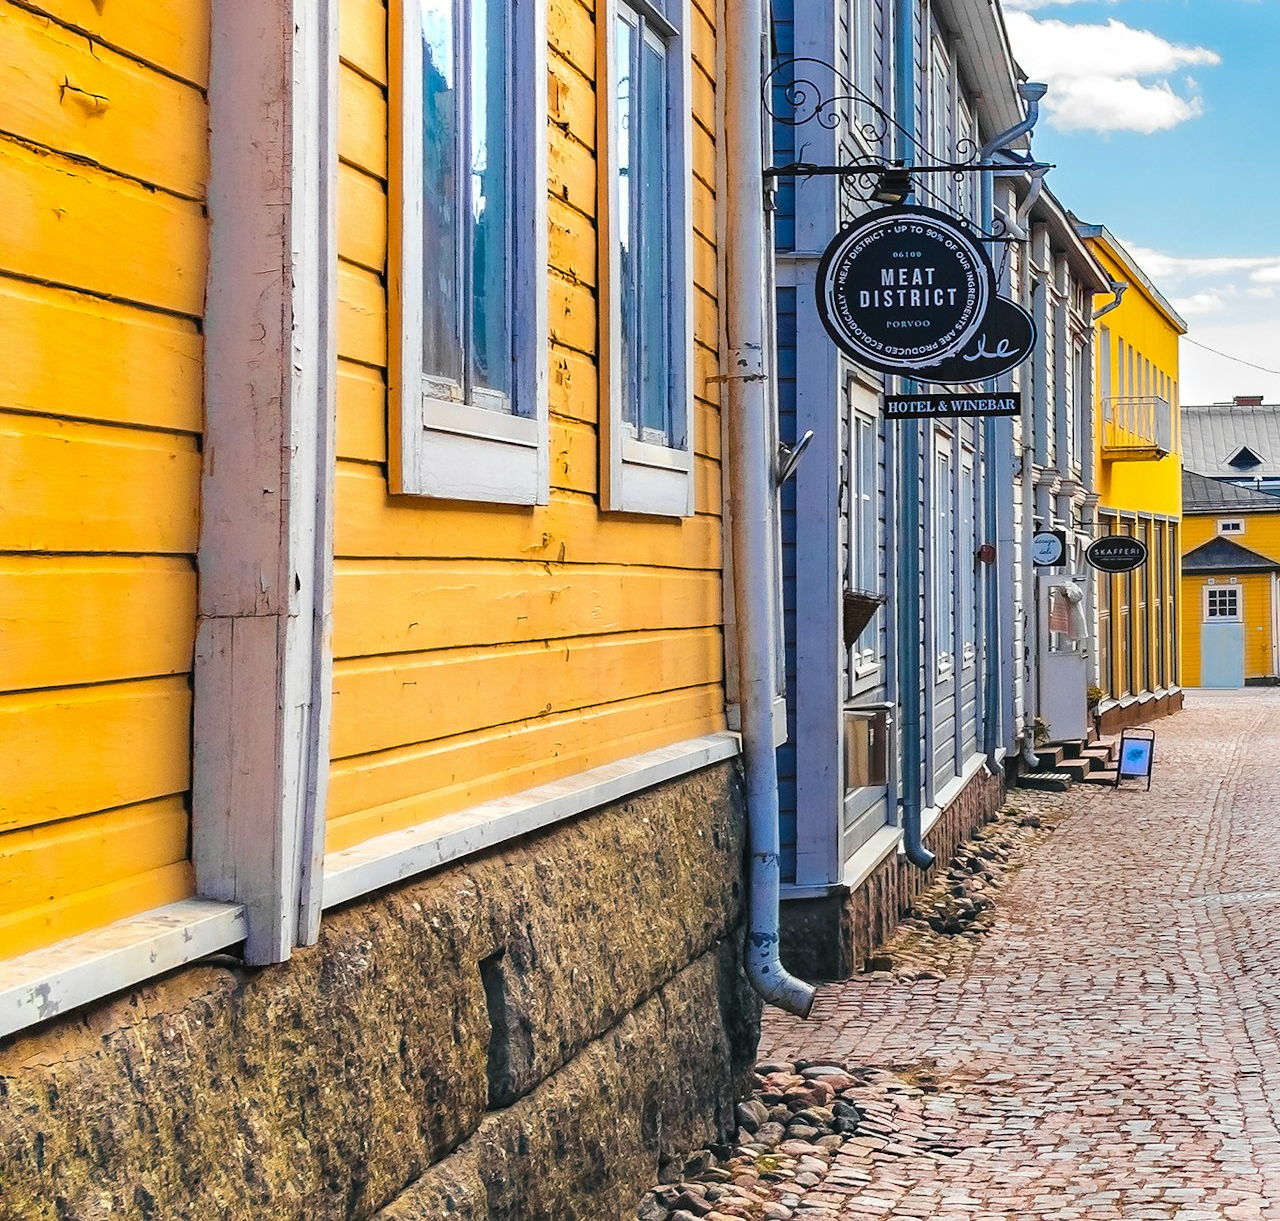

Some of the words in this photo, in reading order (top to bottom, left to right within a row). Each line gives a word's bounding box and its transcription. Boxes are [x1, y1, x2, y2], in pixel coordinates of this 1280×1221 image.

[893, 225, 908, 234] UP
[910, 225, 923, 234] TO
[926, 229, 945, 243] 90%
[849, 229, 885, 260] DISTRICT
[944, 239, 957, 252] OF
[955, 251, 972, 271] OUR
[838, 259, 852, 285] MEAT
[881, 268, 936, 287] MEAT
[859, 288, 957, 308] DISTRICT
[955, 271, 976, 330] INGREDIENTS
[838, 292, 883, 351] ECOLOGICALLY
[886, 320, 931, 328] PORVOO
[940, 329, 957, 346] ARE
[885, 340, 939, 356] PRODUCED
[888, 400, 935, 413] HOTEL
[938, 401, 948, 411] &
[951, 399, 1015, 411] WINEBAR
[1094, 548, 1140, 556] SKAFFERI
